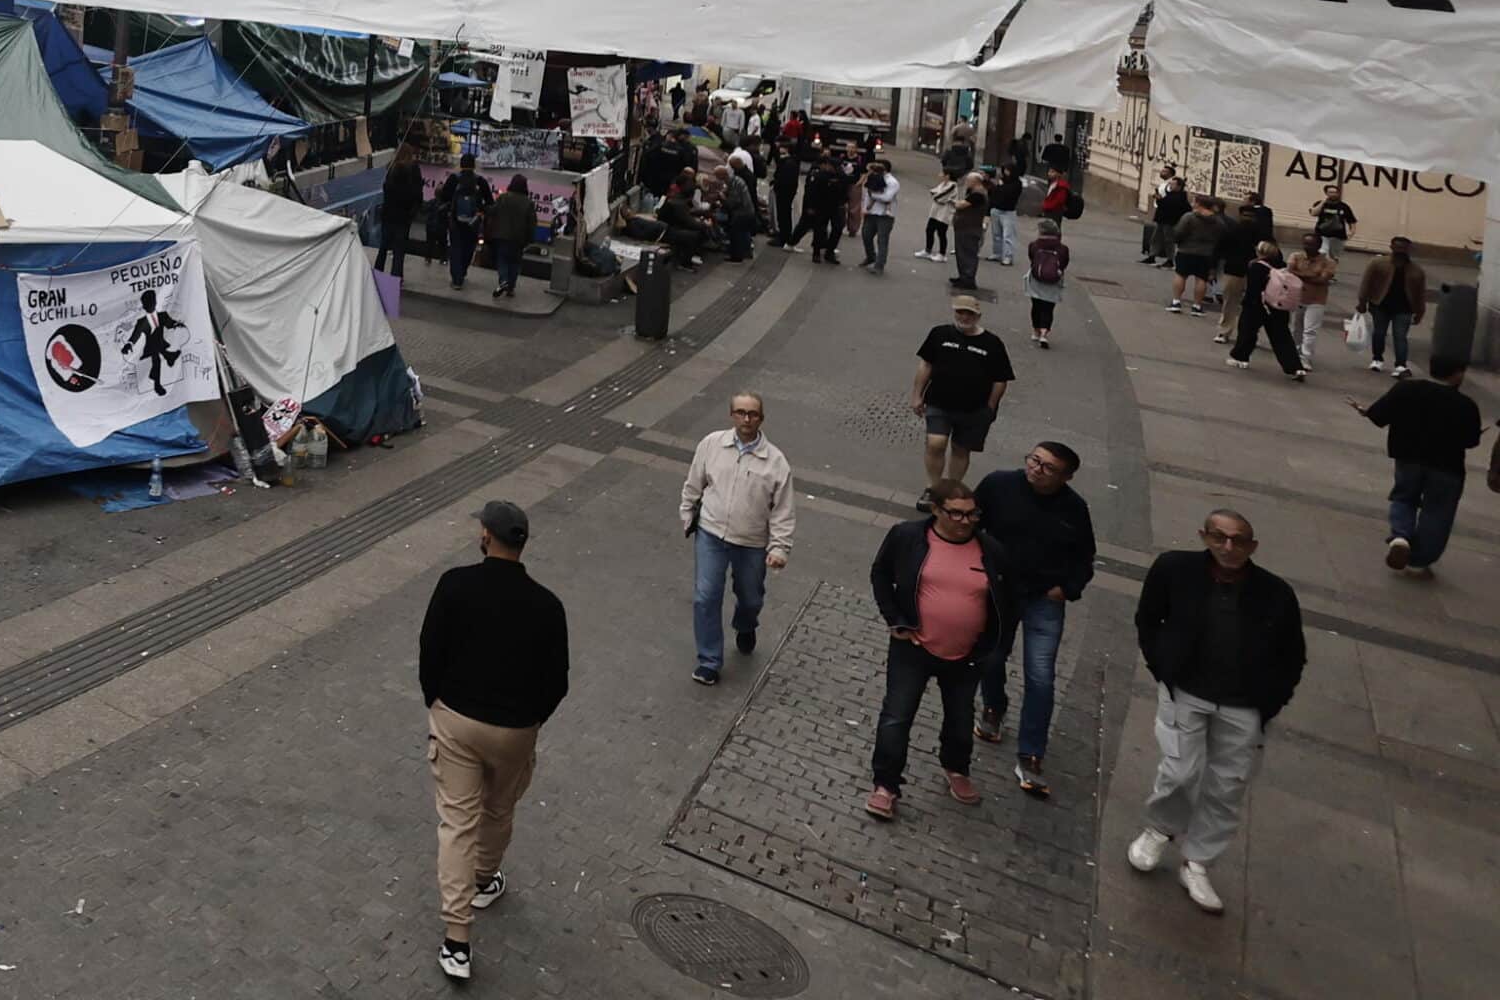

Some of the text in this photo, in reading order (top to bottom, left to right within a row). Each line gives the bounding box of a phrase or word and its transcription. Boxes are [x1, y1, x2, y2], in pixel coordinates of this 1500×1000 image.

[1220, 146, 1261, 169] DIEGO
[110, 254, 183, 285] PEQUEÑO
[130, 273, 180, 294] TENEDOR
[27, 287, 68, 309] GRAN
[29, 302, 98, 325] CUCHILLO
